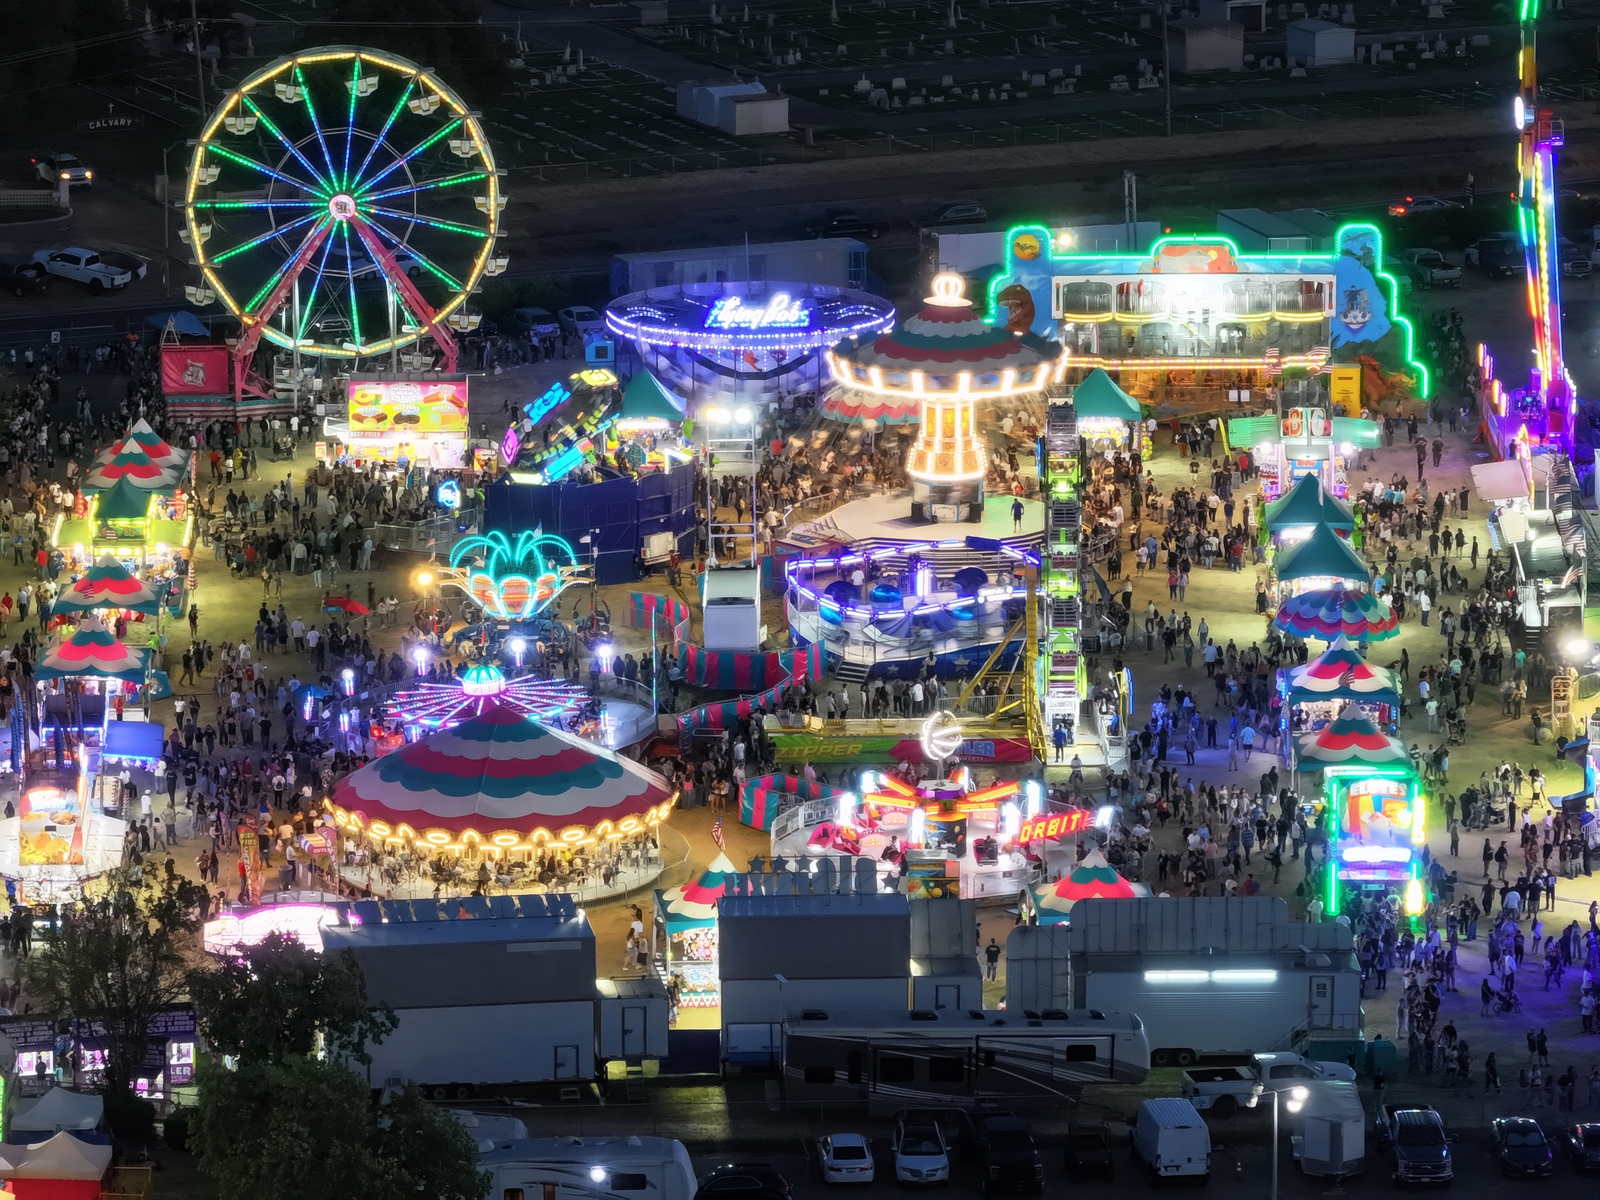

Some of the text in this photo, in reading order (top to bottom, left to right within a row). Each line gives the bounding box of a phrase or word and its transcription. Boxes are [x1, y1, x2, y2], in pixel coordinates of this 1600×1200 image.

[89, 119, 132, 130] CALVARY
[775, 744, 864, 758] ZIPPER
[239, 832, 255, 840] DEEP
[243, 845, 252, 878] CANDY
